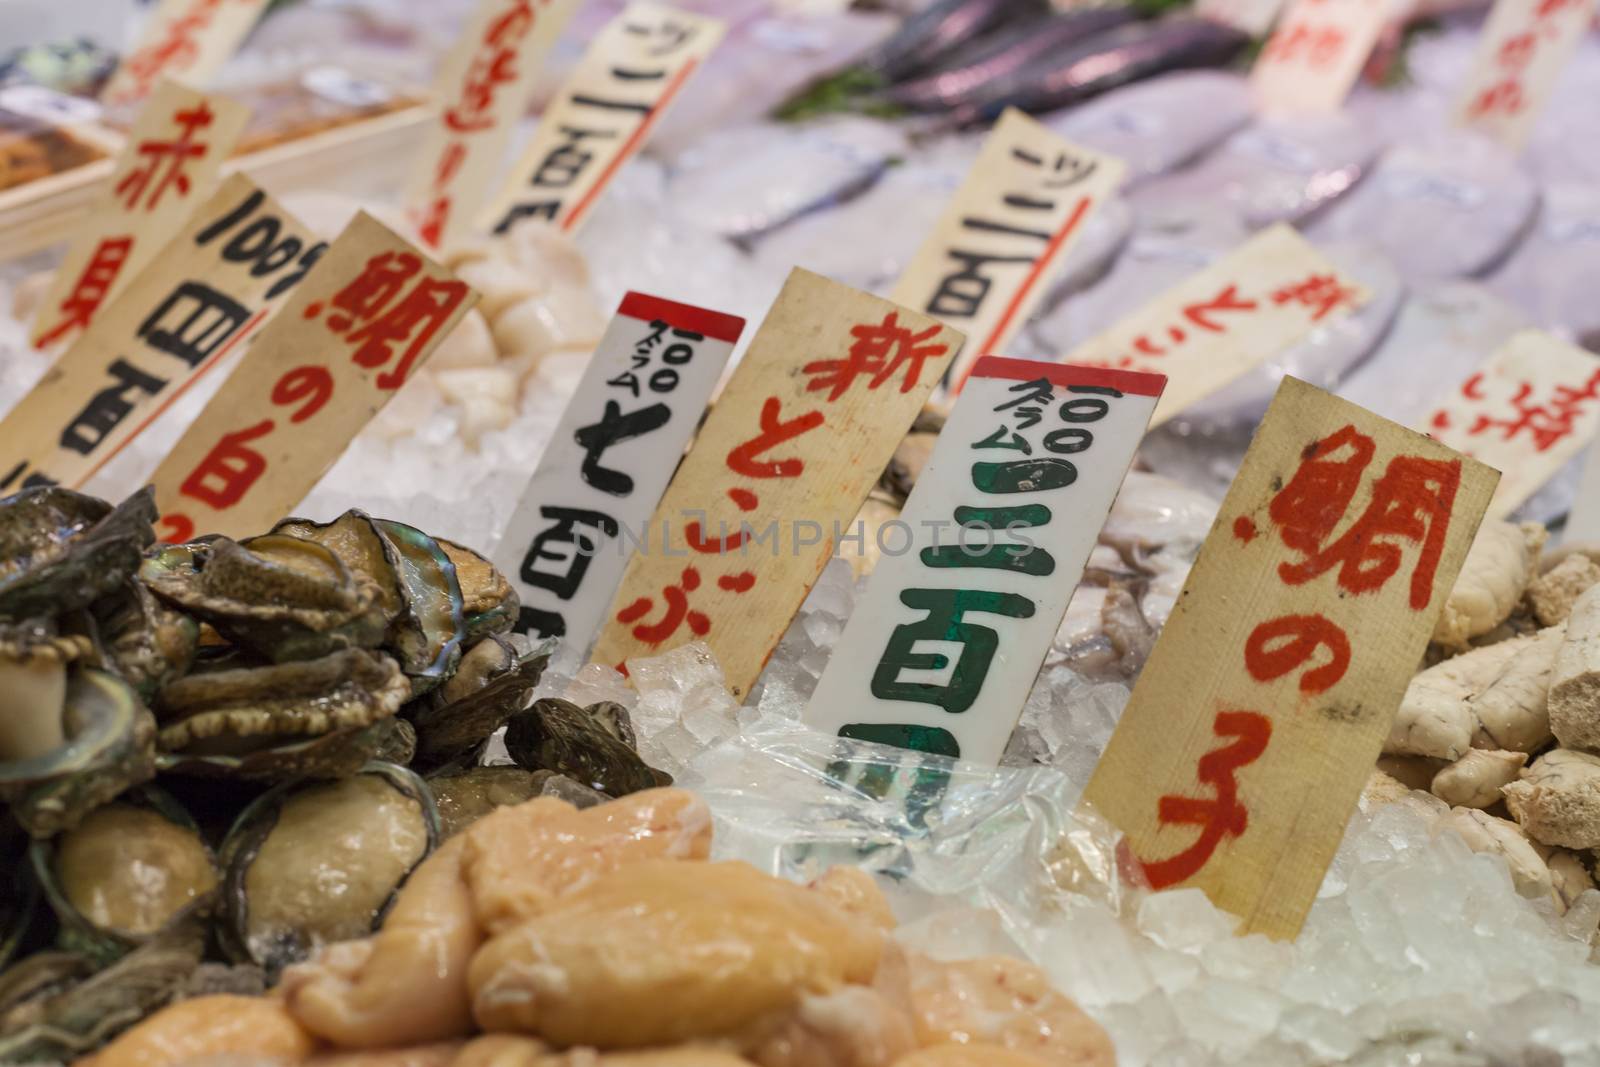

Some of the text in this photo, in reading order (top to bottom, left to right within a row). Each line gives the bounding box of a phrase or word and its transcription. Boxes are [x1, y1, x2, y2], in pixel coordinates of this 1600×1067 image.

[35, 101, 215, 350] 赤貝
[1, 280, 255, 490] 四百
[614, 311, 949, 680] 新とこぶ
[1117, 424, 1462, 892] 鯛の子
